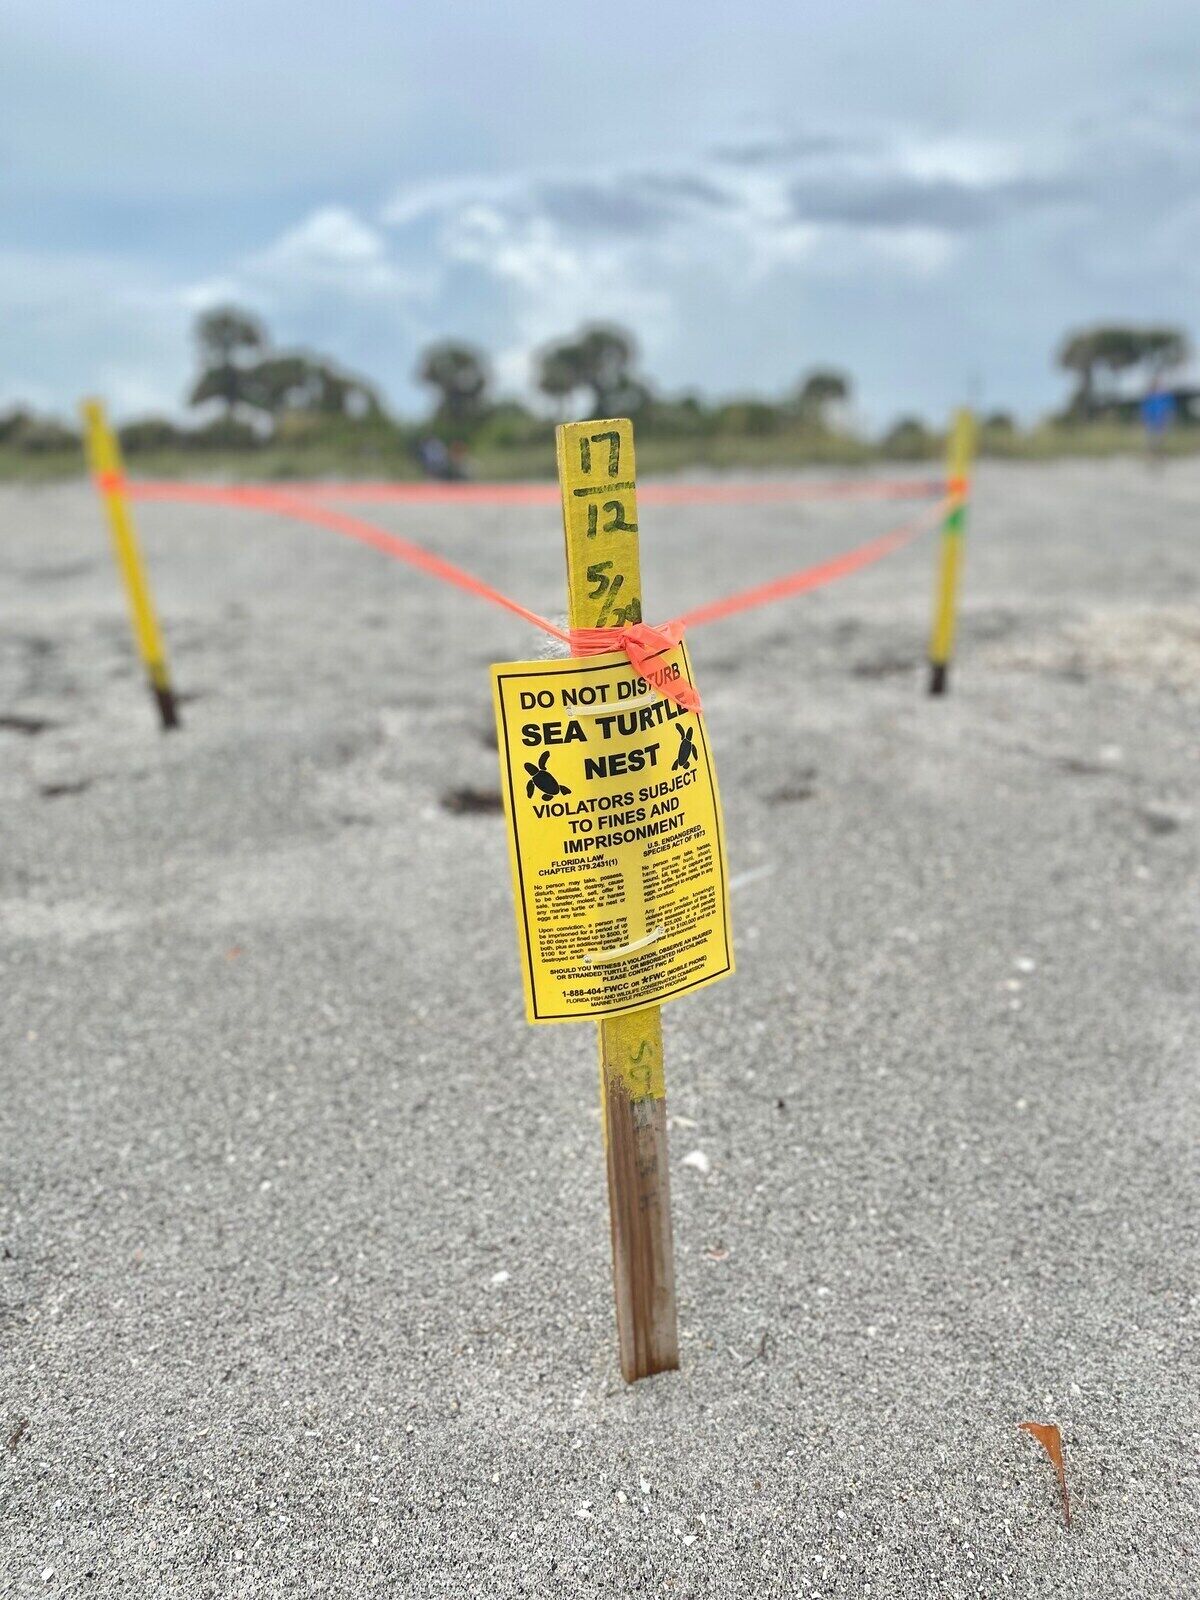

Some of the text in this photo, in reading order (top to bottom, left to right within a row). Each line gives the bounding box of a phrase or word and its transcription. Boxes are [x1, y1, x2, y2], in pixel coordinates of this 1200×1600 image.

[579, 431, 620, 477] 17
[587, 500, 638, 539] 12
[520, 662, 681, 710] DO NOT DISTURB
[521, 695, 688, 746] SEA TURTLE
[584, 743, 660, 780] NEST
[533, 769, 698, 818] VIOLATORS SUBJECT
[569, 797, 679, 833] TO FINES AND
[564, 813, 685, 854] IMPRISONMENT
[643, 844, 670, 857] SPECIES
[672, 839, 683, 847] ACT
[694, 830, 705, 839] 1973
[662, 825, 701, 845] ENDANGERED
[539, 859, 618, 876] CHAPTER 379.2431(1)
[551, 854, 604, 867] FLORIDA LAW
[653, 860, 668, 868] person
[593, 962, 621, 970] WITNESS
[628, 952, 657, 965] VIOLATION,
[659, 943, 683, 954] OBSERVE
[692, 930, 712, 942] INJURED
[604, 936, 622, 945] penalty
[562, 982, 629, 997] 1-888-404-FWCC
[666, 962, 688, 976] (MOBILE
[688, 955, 708, 966] PHONE)
[568, 971, 602, 979] STRANDED
[604, 967, 628, 975] TURTLE,
[640, 952, 676, 968] MISORIENTED
[616, 988, 640, 998] WILDLIFE
[640, 974, 676, 991] CONSERVATION
[676, 964, 705, 978] COMMISSION
[629, 965, 654, 977] CONTACT
[656, 960, 668, 968] FWC
[613, 996, 632, 1004] TURTLE
[632, 986, 664, 998] PROTECTION
[664, 976, 688, 988] PROGRAM
